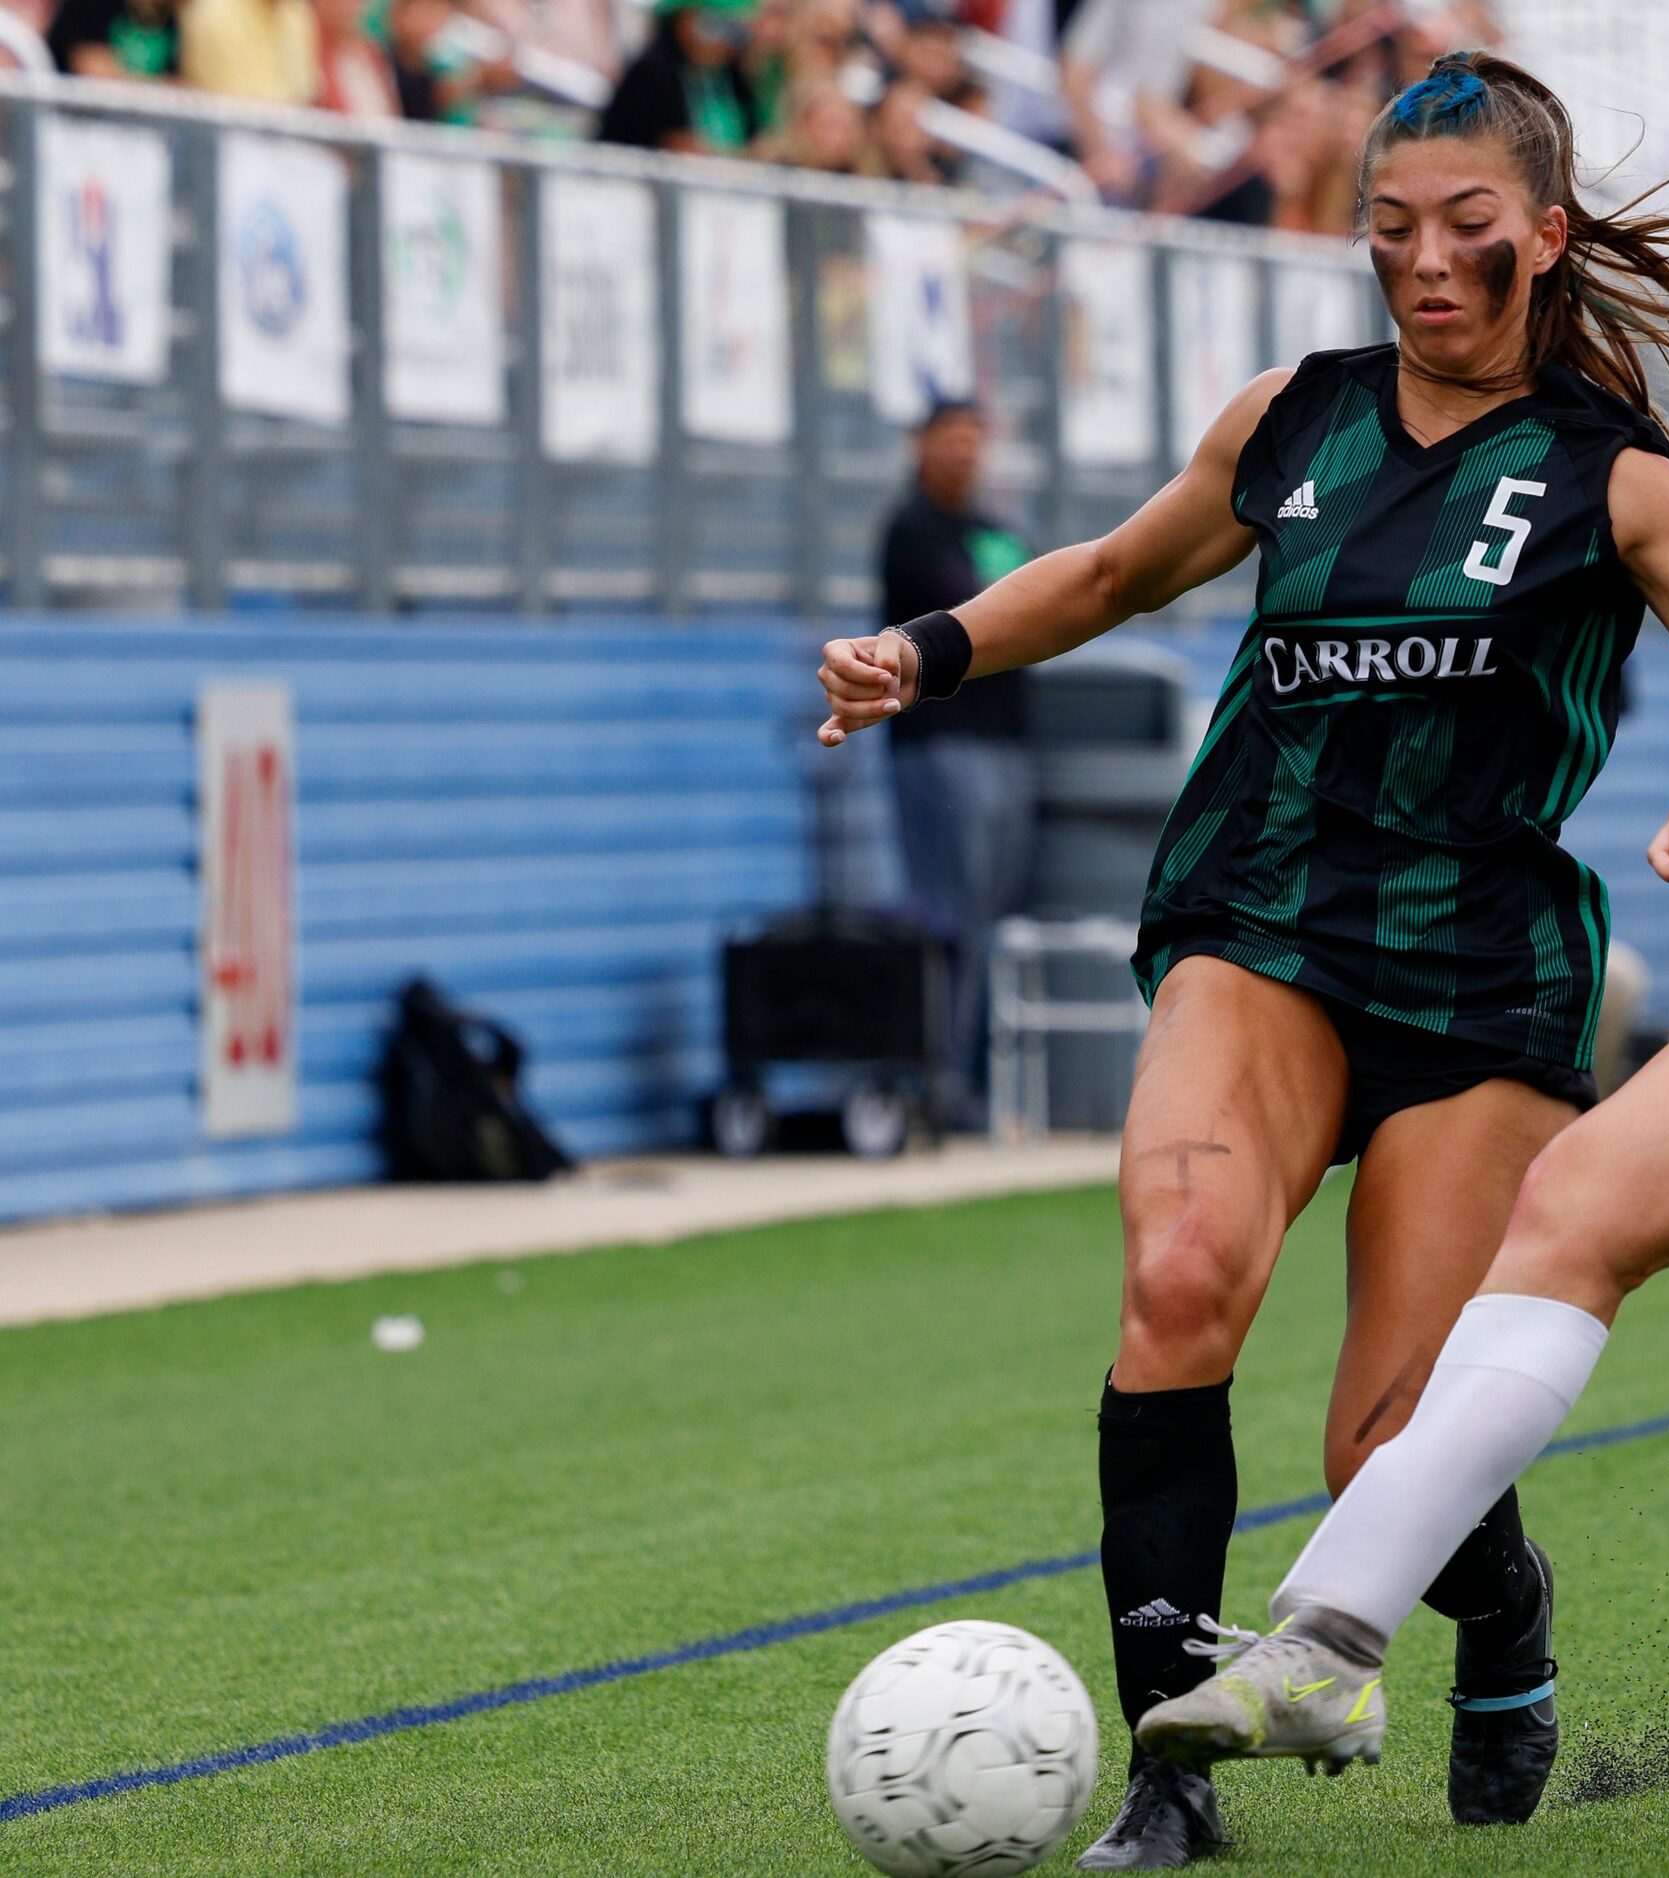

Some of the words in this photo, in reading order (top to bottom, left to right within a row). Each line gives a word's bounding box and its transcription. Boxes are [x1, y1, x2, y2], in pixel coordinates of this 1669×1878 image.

[1277, 504, 1319, 519] adidas
[1463, 476, 1547, 585] 5
[1264, 637, 1498, 695] CARROLL
[1120, 1614, 1190, 1627] adidas
